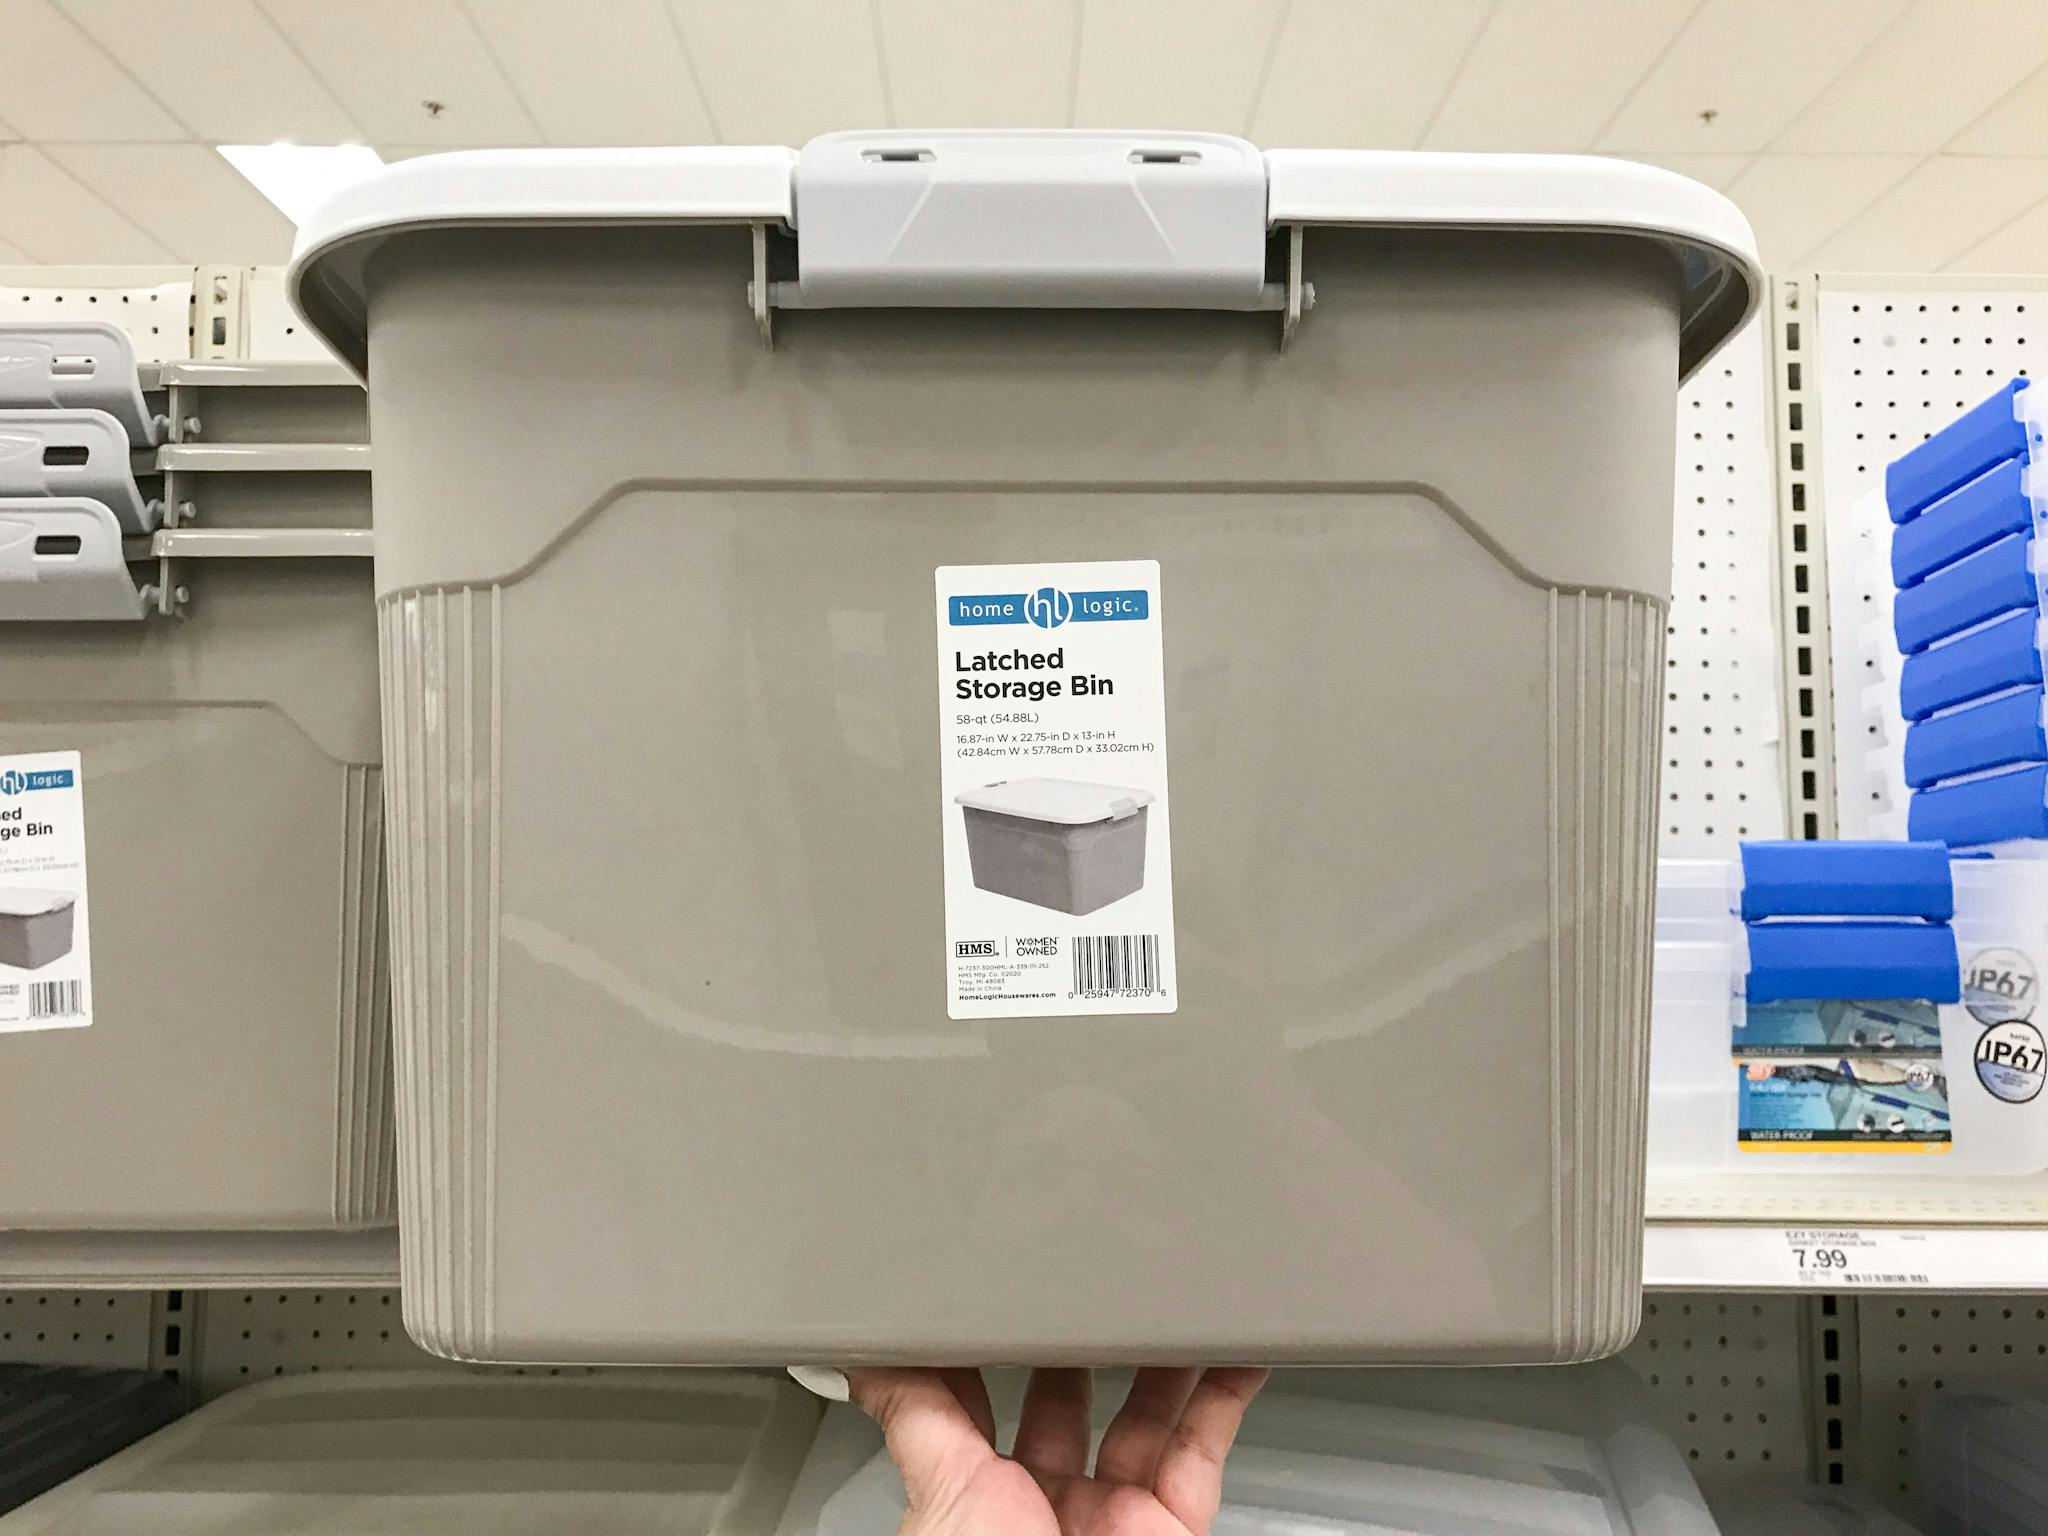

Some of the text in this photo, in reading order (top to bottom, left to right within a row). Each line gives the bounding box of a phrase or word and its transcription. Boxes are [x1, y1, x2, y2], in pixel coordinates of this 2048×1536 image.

[959, 601, 1014, 617] home
[955, 648, 1064, 672] Latched
[956, 674, 1114, 702] Storage Bin
[956, 712, 1039, 725] 58-qt (54.88L)
[957, 734, 994, 743] 16.87-in
[997, 733, 1008, 742] W
[1020, 731, 1060, 742] 22.75-in
[1062, 732, 1071, 740] D
[1081, 731, 1105, 740] 13-in
[1107, 730, 1115, 739] H
[957, 747, 1006, 758] (42.84cm
[1008, 746, 1020, 755] W
[1032, 745, 1073, 755] 57.78cm
[1075, 745, 1084, 754] D
[1095, 743, 1139, 753] 33.02cm
[1141, 742, 1154, 752] H)
[32, 774, 64, 787] logic
[0, 806, 22, 820] ed
[27, 822, 53, 836] Bin
[958, 943, 993, 955] HMS
[1016, 946, 1057, 956] OWNED
[1068, 988, 1167, 999] 0 25947 72370 6
[1983, 1039, 2044, 1073] IP67
[1791, 1249, 1847, 1268] 7.99
